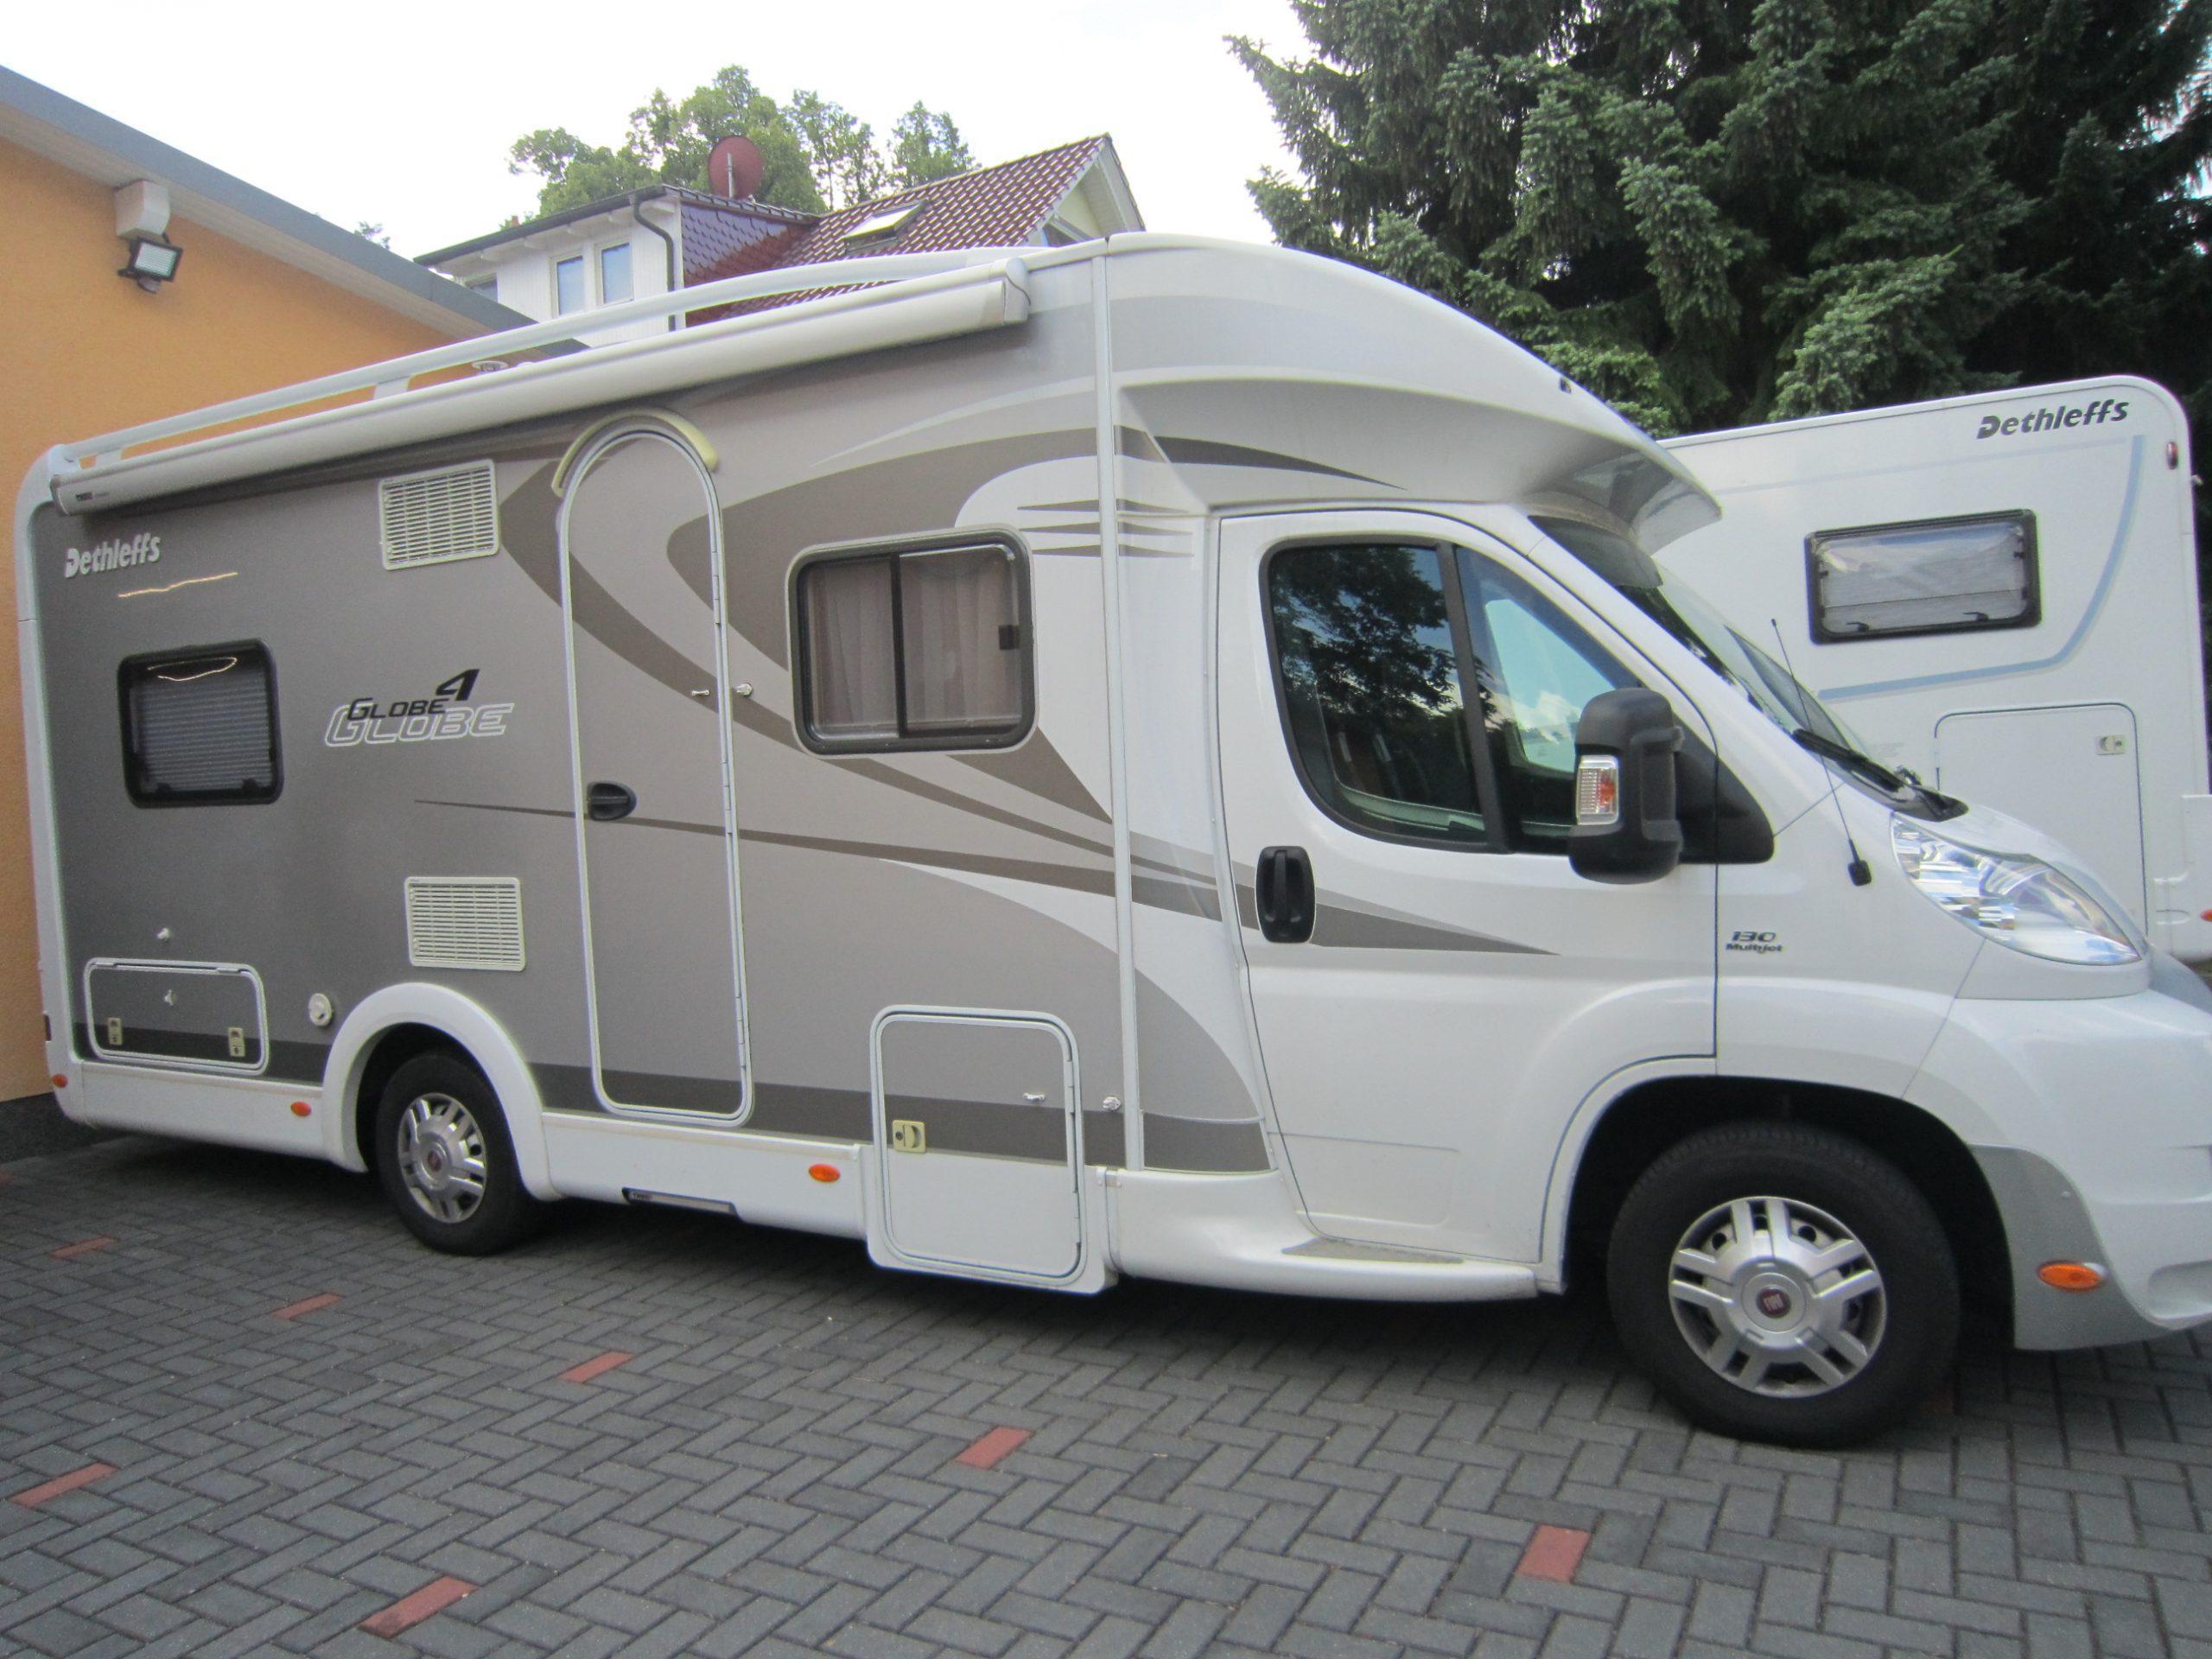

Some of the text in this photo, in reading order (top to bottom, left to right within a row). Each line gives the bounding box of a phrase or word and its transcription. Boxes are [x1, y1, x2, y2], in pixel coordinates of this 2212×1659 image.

[1976, 398, 2130, 440] Dethleffs
[64, 532, 162, 579] Dethleffs
[435, 668, 480, 702] 4
[324, 702, 515, 747] GLOBE
[1732, 931, 1777, 943] 130
